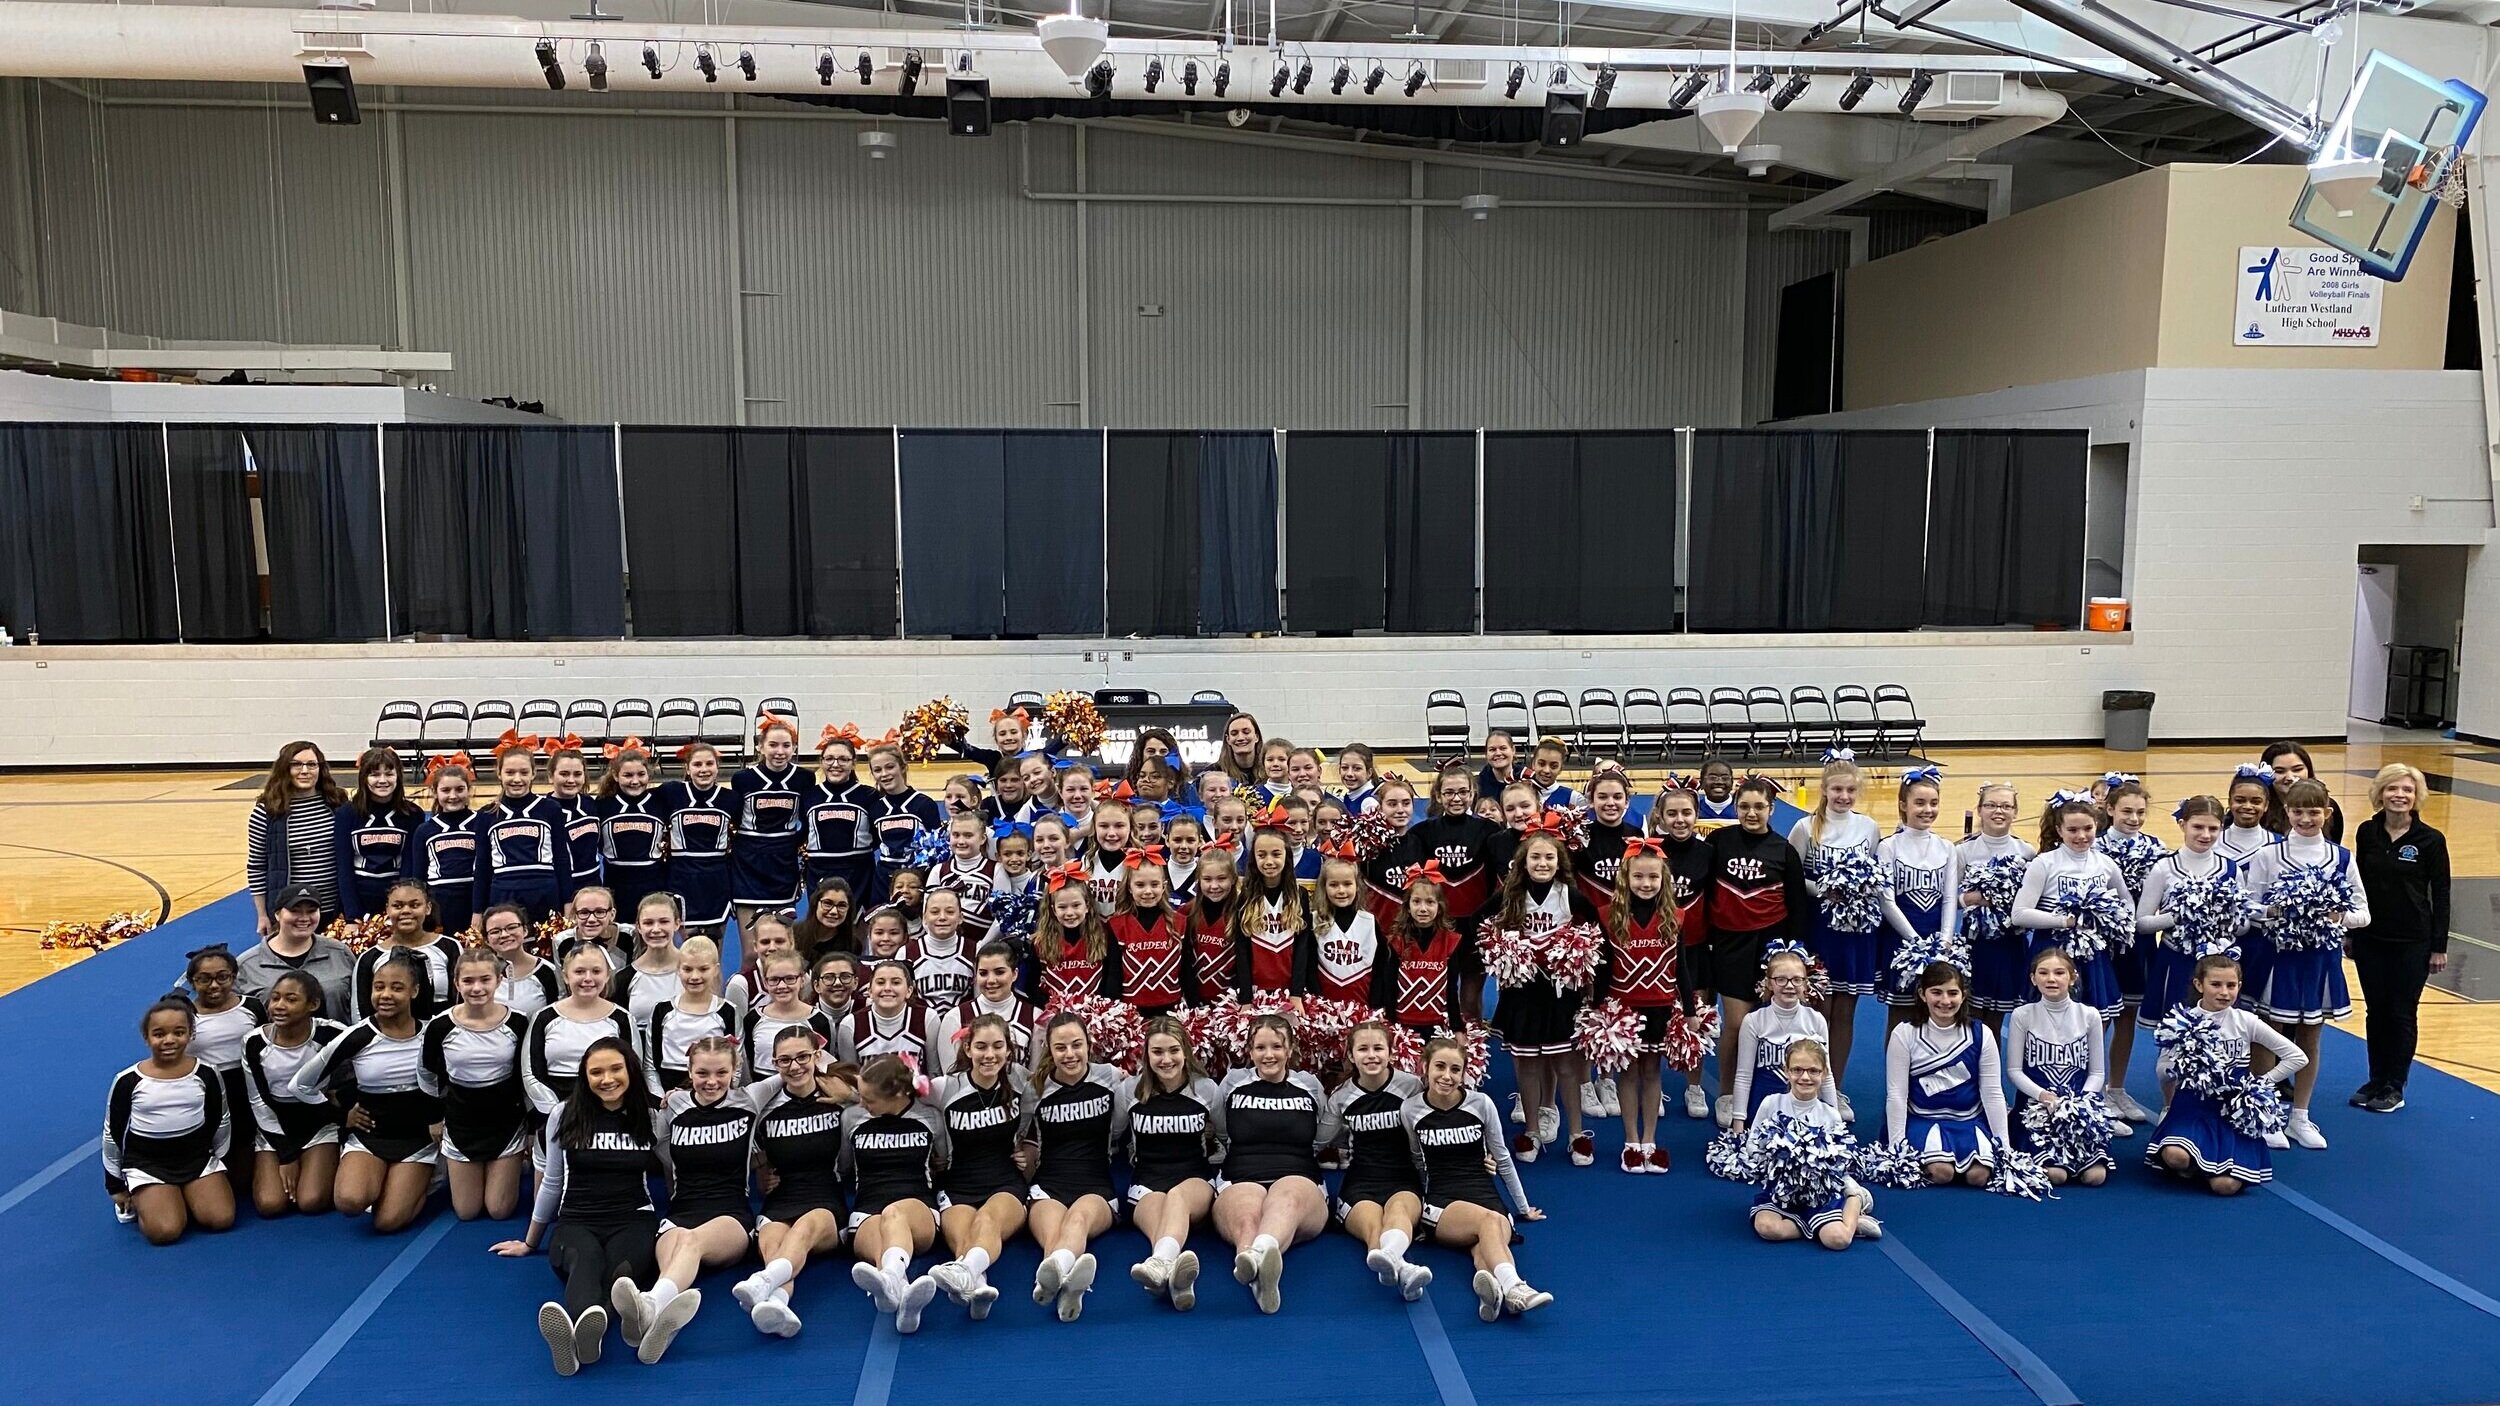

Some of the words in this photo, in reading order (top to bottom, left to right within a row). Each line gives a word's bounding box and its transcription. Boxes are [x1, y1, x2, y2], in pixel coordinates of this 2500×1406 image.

[2309, 253, 2338, 263] Good
[2341, 252, 2362, 265] Spo
[2307, 266, 2326, 276] Are
[2321, 281, 2339, 289] 2008
[2341, 281, 2360, 289] Girls
[2309, 291, 2346, 299] Volleyball
[2347, 291, 2371, 299] Finals
[2265, 303, 2307, 313] Lutheran
[2310, 304, 2353, 314] Westland
[2281, 317, 2304, 329] High
[2306, 318, 2337, 328] School
[1113, 695, 1129, 703] POSS
[1104, 729, 1136, 741] eran
[757, 798, 794, 810] CHARGERS
[682, 814, 720, 826] CHARGERS
[818, 810, 855, 822] CHARGERS
[498, 826, 539, 841] CHARGERS
[612, 822, 652, 834] CHARGERS
[360, 833, 401, 846] CHARGERS
[434, 838, 475, 852] CHARGERS
[1434, 845, 1473, 868] SML
[1594, 857, 1620, 881] SM
[1727, 857, 1767, 880] SML
[1323, 939, 1363, 966] SML
[1401, 960, 1444, 971] RAIDERS
[2027, 1030, 2089, 1070] COUGARS
[1040, 1095, 1110, 1123] WARRIORS
[1231, 1093, 1313, 1112] WARRIORS
[950, 1097, 1020, 1131] WARRIOS
[1345, 1110, 1401, 1132] WARRIOR
[766, 1110, 840, 1139] WARRIORS
[1131, 1112, 1205, 1135] WARRIORS
[671, 1115, 749, 1147] WARRIORS
[1417, 1124, 1482, 1146] WARRIORS
[855, 1131, 928, 1149] WARRIORS
